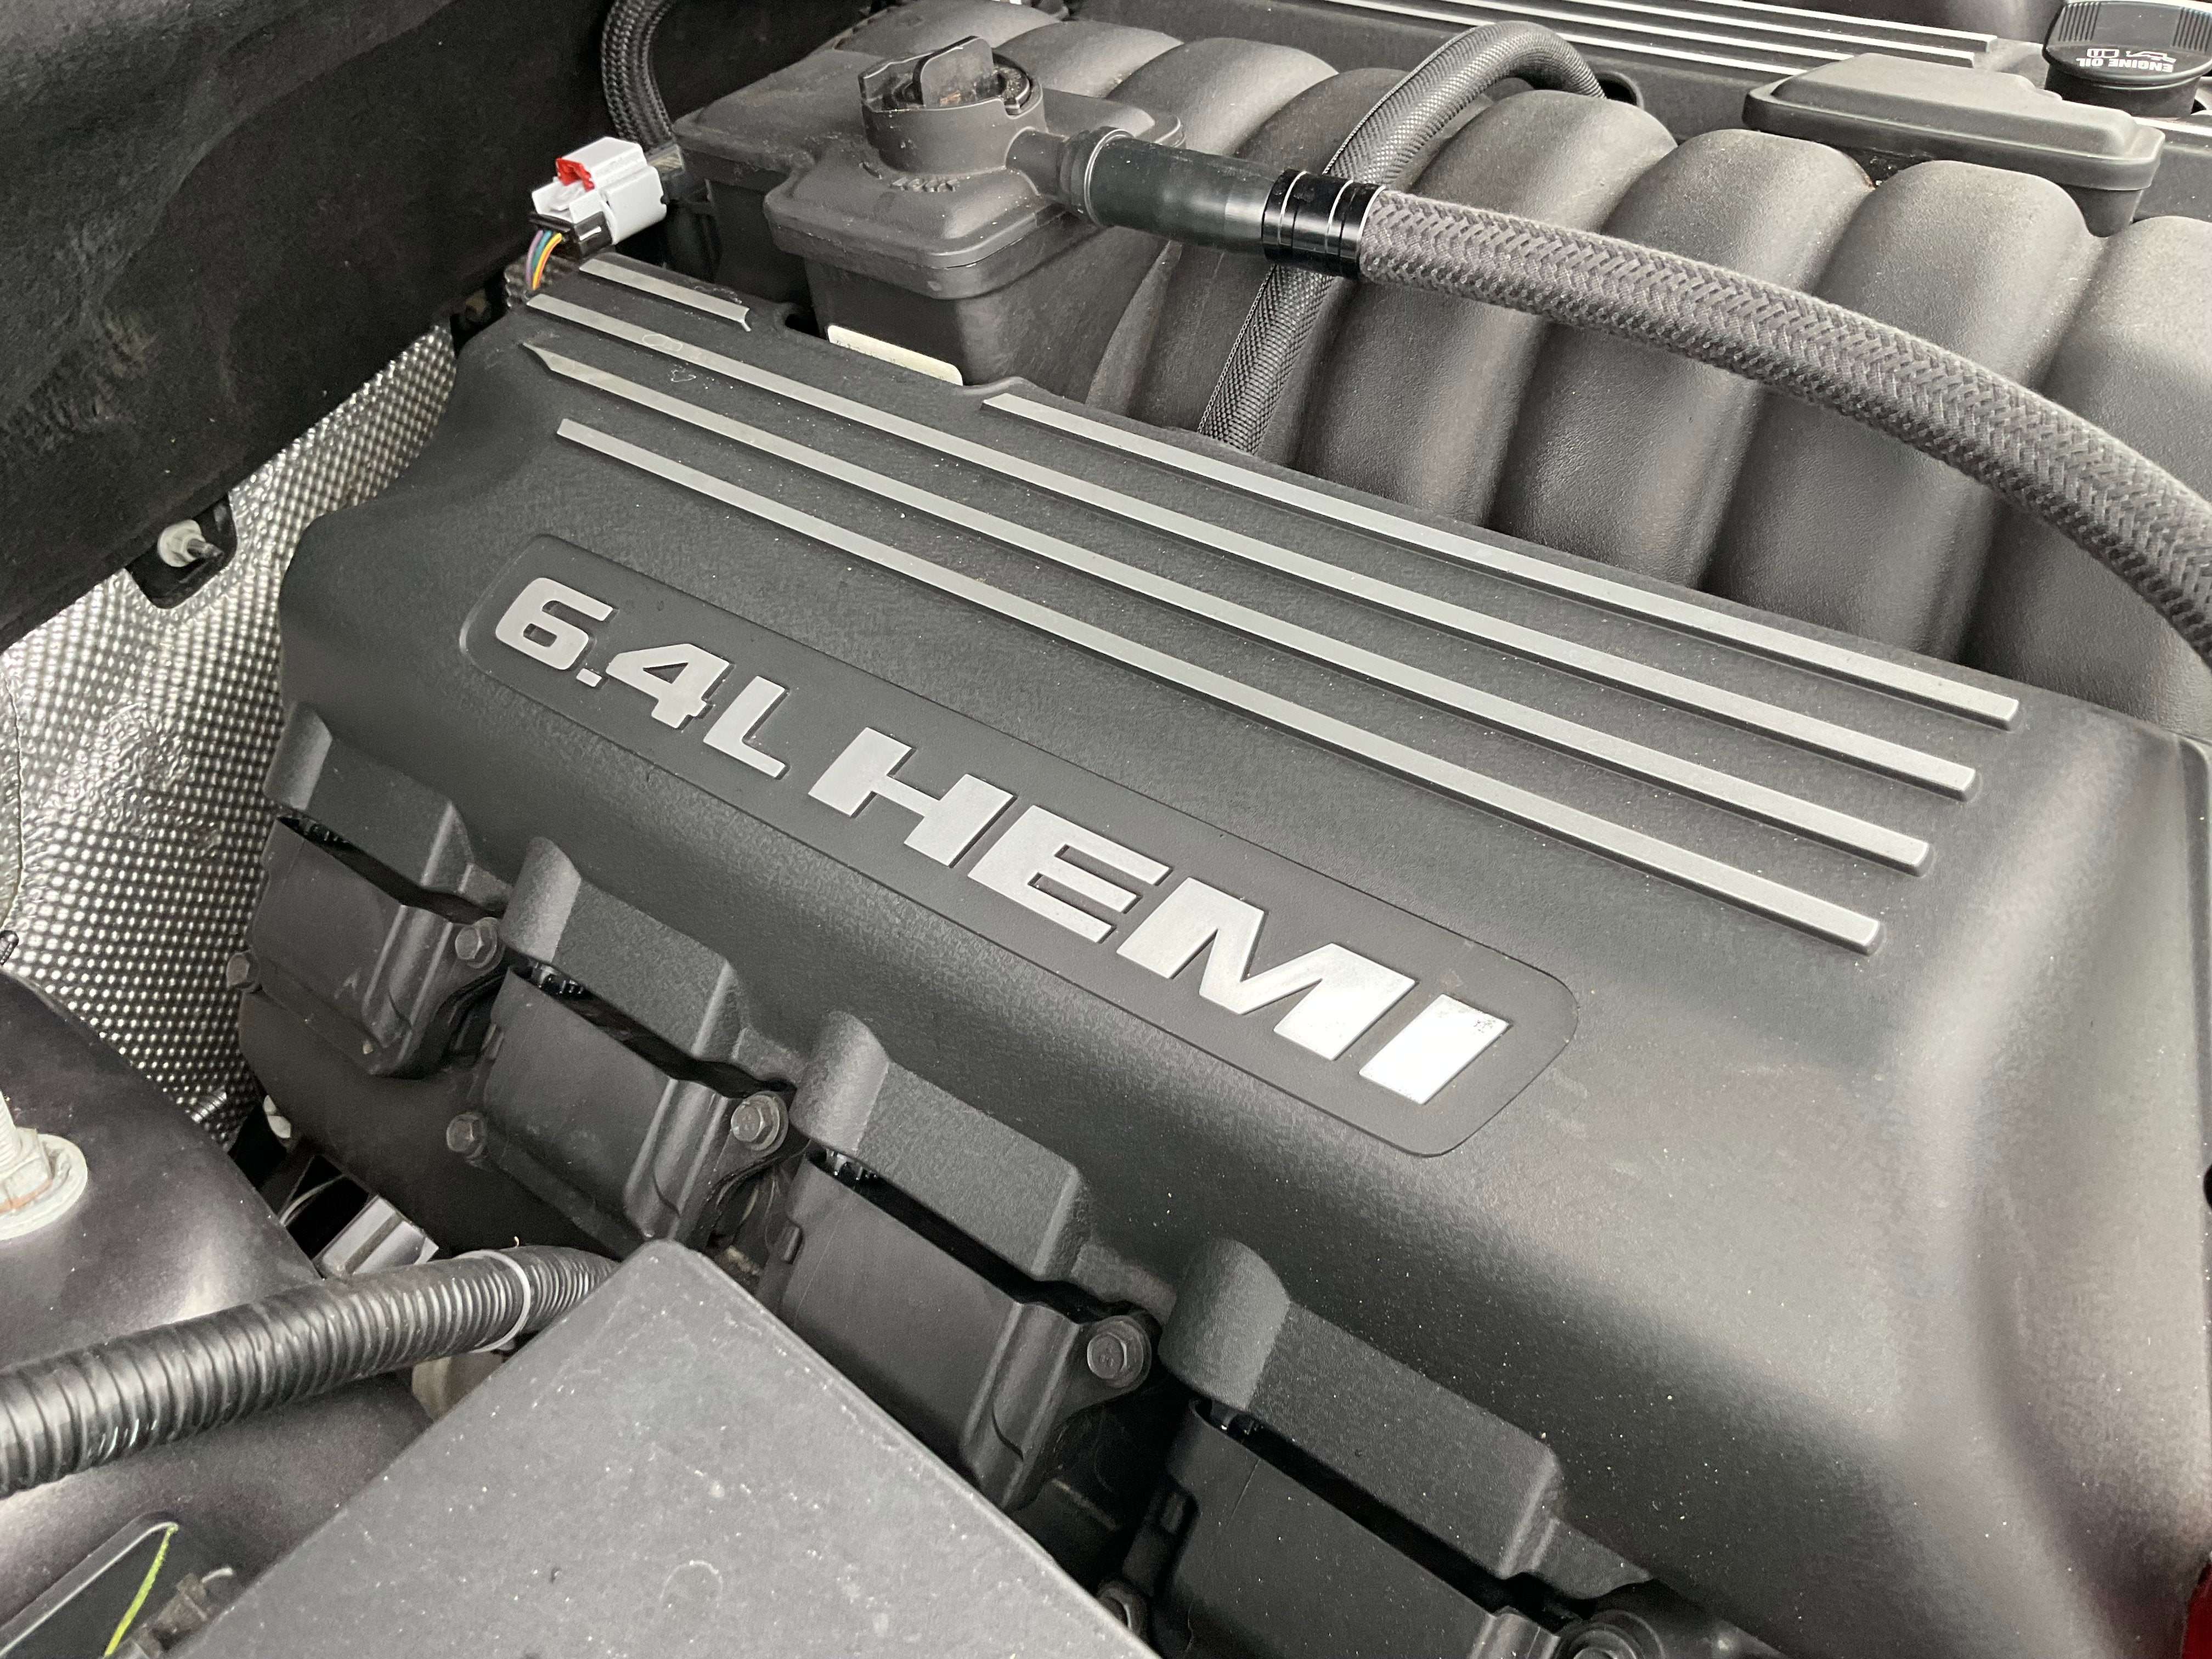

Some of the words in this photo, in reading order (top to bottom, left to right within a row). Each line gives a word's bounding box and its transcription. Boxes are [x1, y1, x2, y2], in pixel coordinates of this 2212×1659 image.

[2076, 58, 2104, 67] OIL
[2108, 58, 2174, 72] ENGINE
[495, 577, 787, 778] 6.4L
[808, 727, 1510, 1104] HEMI
